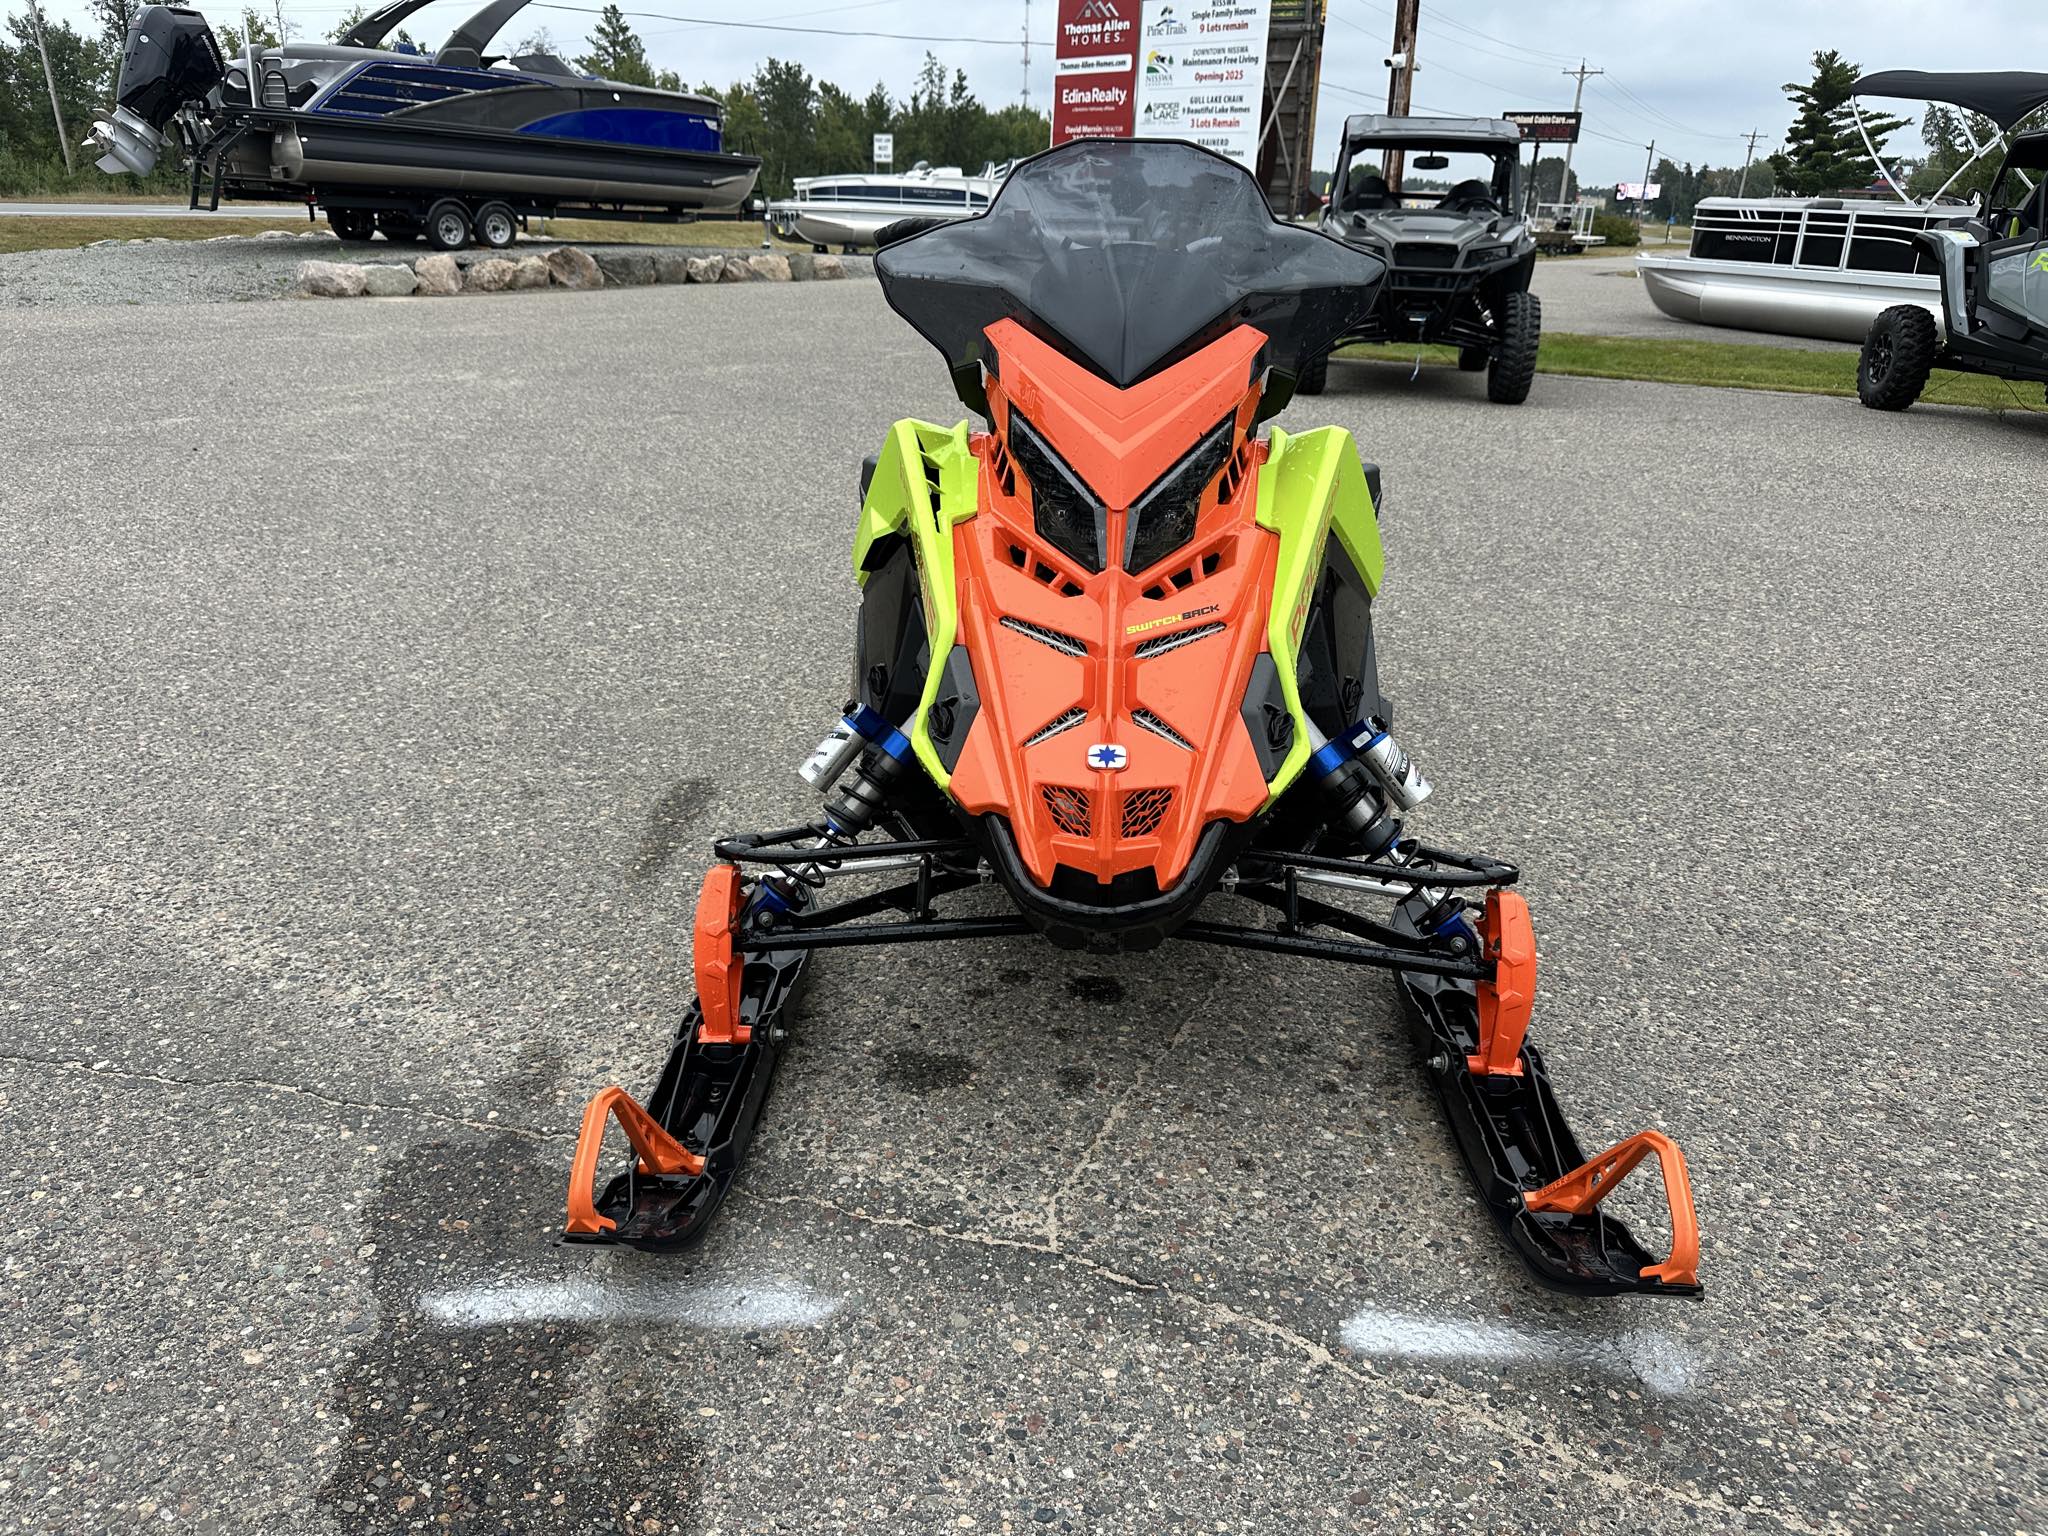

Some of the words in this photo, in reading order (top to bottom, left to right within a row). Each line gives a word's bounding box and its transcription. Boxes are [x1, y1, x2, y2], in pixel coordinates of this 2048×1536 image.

[1191, 11, 1210, 21] Single
[1211, 9, 1233, 19] Family
[1234, 7, 1257, 16] Homes
[1064, 22, 1102, 35] Thomas
[1103, 19, 1131, 31] Allen
[1146, 25, 1165, 37] Pine
[1165, 23, 1188, 35] Trails
[1199, 23, 1205, 33] 9
[1206, 22, 1221, 32] Lots
[1222, 20, 1249, 31] remain
[1070, 32, 1121, 46] HOMES
[200, 34, 221, 72] MERCURY
[1192, 47, 1226, 56] DOWNTOWN
[1182, 56, 1222, 67] Maintenance
[1223, 56, 1238, 65] Free
[1238, 54, 1259, 65] Living
[1194, 71, 1224, 83] Opening
[1225, 69, 1244, 80] 2025
[1206, 95, 1222, 104] LAKE
[1223, 94, 1244, 103] CHAIN
[1153, 102, 1180, 110] SPIDER
[1186, 106, 1214, 115] Beautiful
[1214, 106, 1229, 114] Lake
[1229, 105, 1250, 113] Homes
[1153, 110, 1179, 120] LAKE
[1190, 119, 1195, 128] 3
[1196, 118, 1211, 128] Lots
[1212, 117, 1240, 127] Remain
[1725, 234, 1772, 243] BENNINGTON
[1125, 604, 1220, 635] SWITCHBACK
